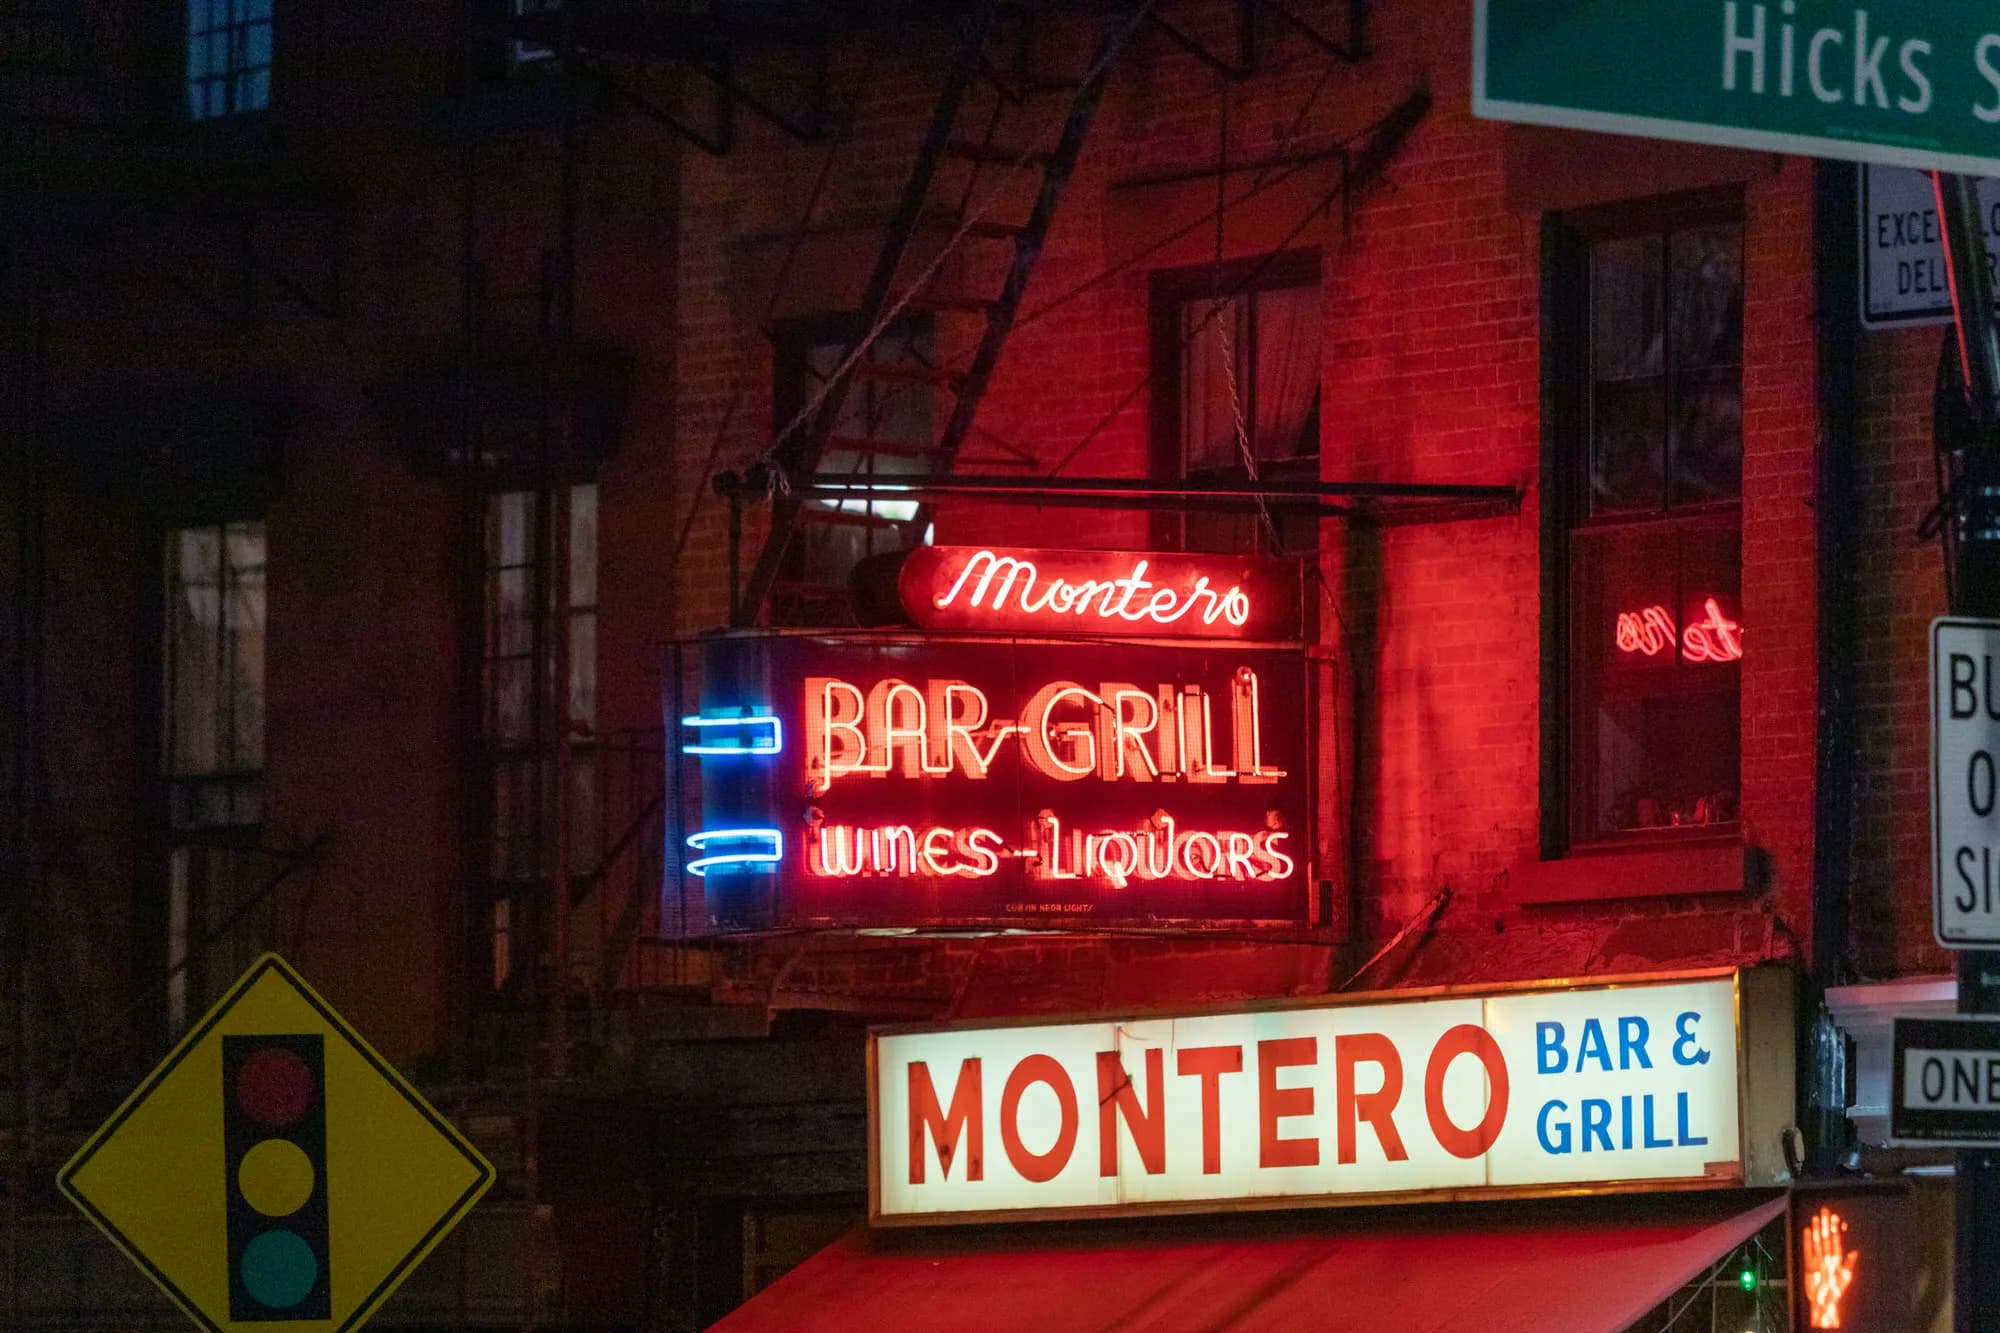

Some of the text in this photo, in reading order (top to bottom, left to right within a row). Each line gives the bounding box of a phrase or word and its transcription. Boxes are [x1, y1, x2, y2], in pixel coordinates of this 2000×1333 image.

[1722, 0, 1932, 113] Hicks
[936, 550, 1250, 626] Montero
[1955, 846, 2000, 912] SI
[1536, 1011, 1711, 1075] BAR &
[908, 1024, 1509, 1184] MONTERO
[1922, 1057, 2000, 1104] ONE
[1537, 1092, 1708, 1155] GRILL
